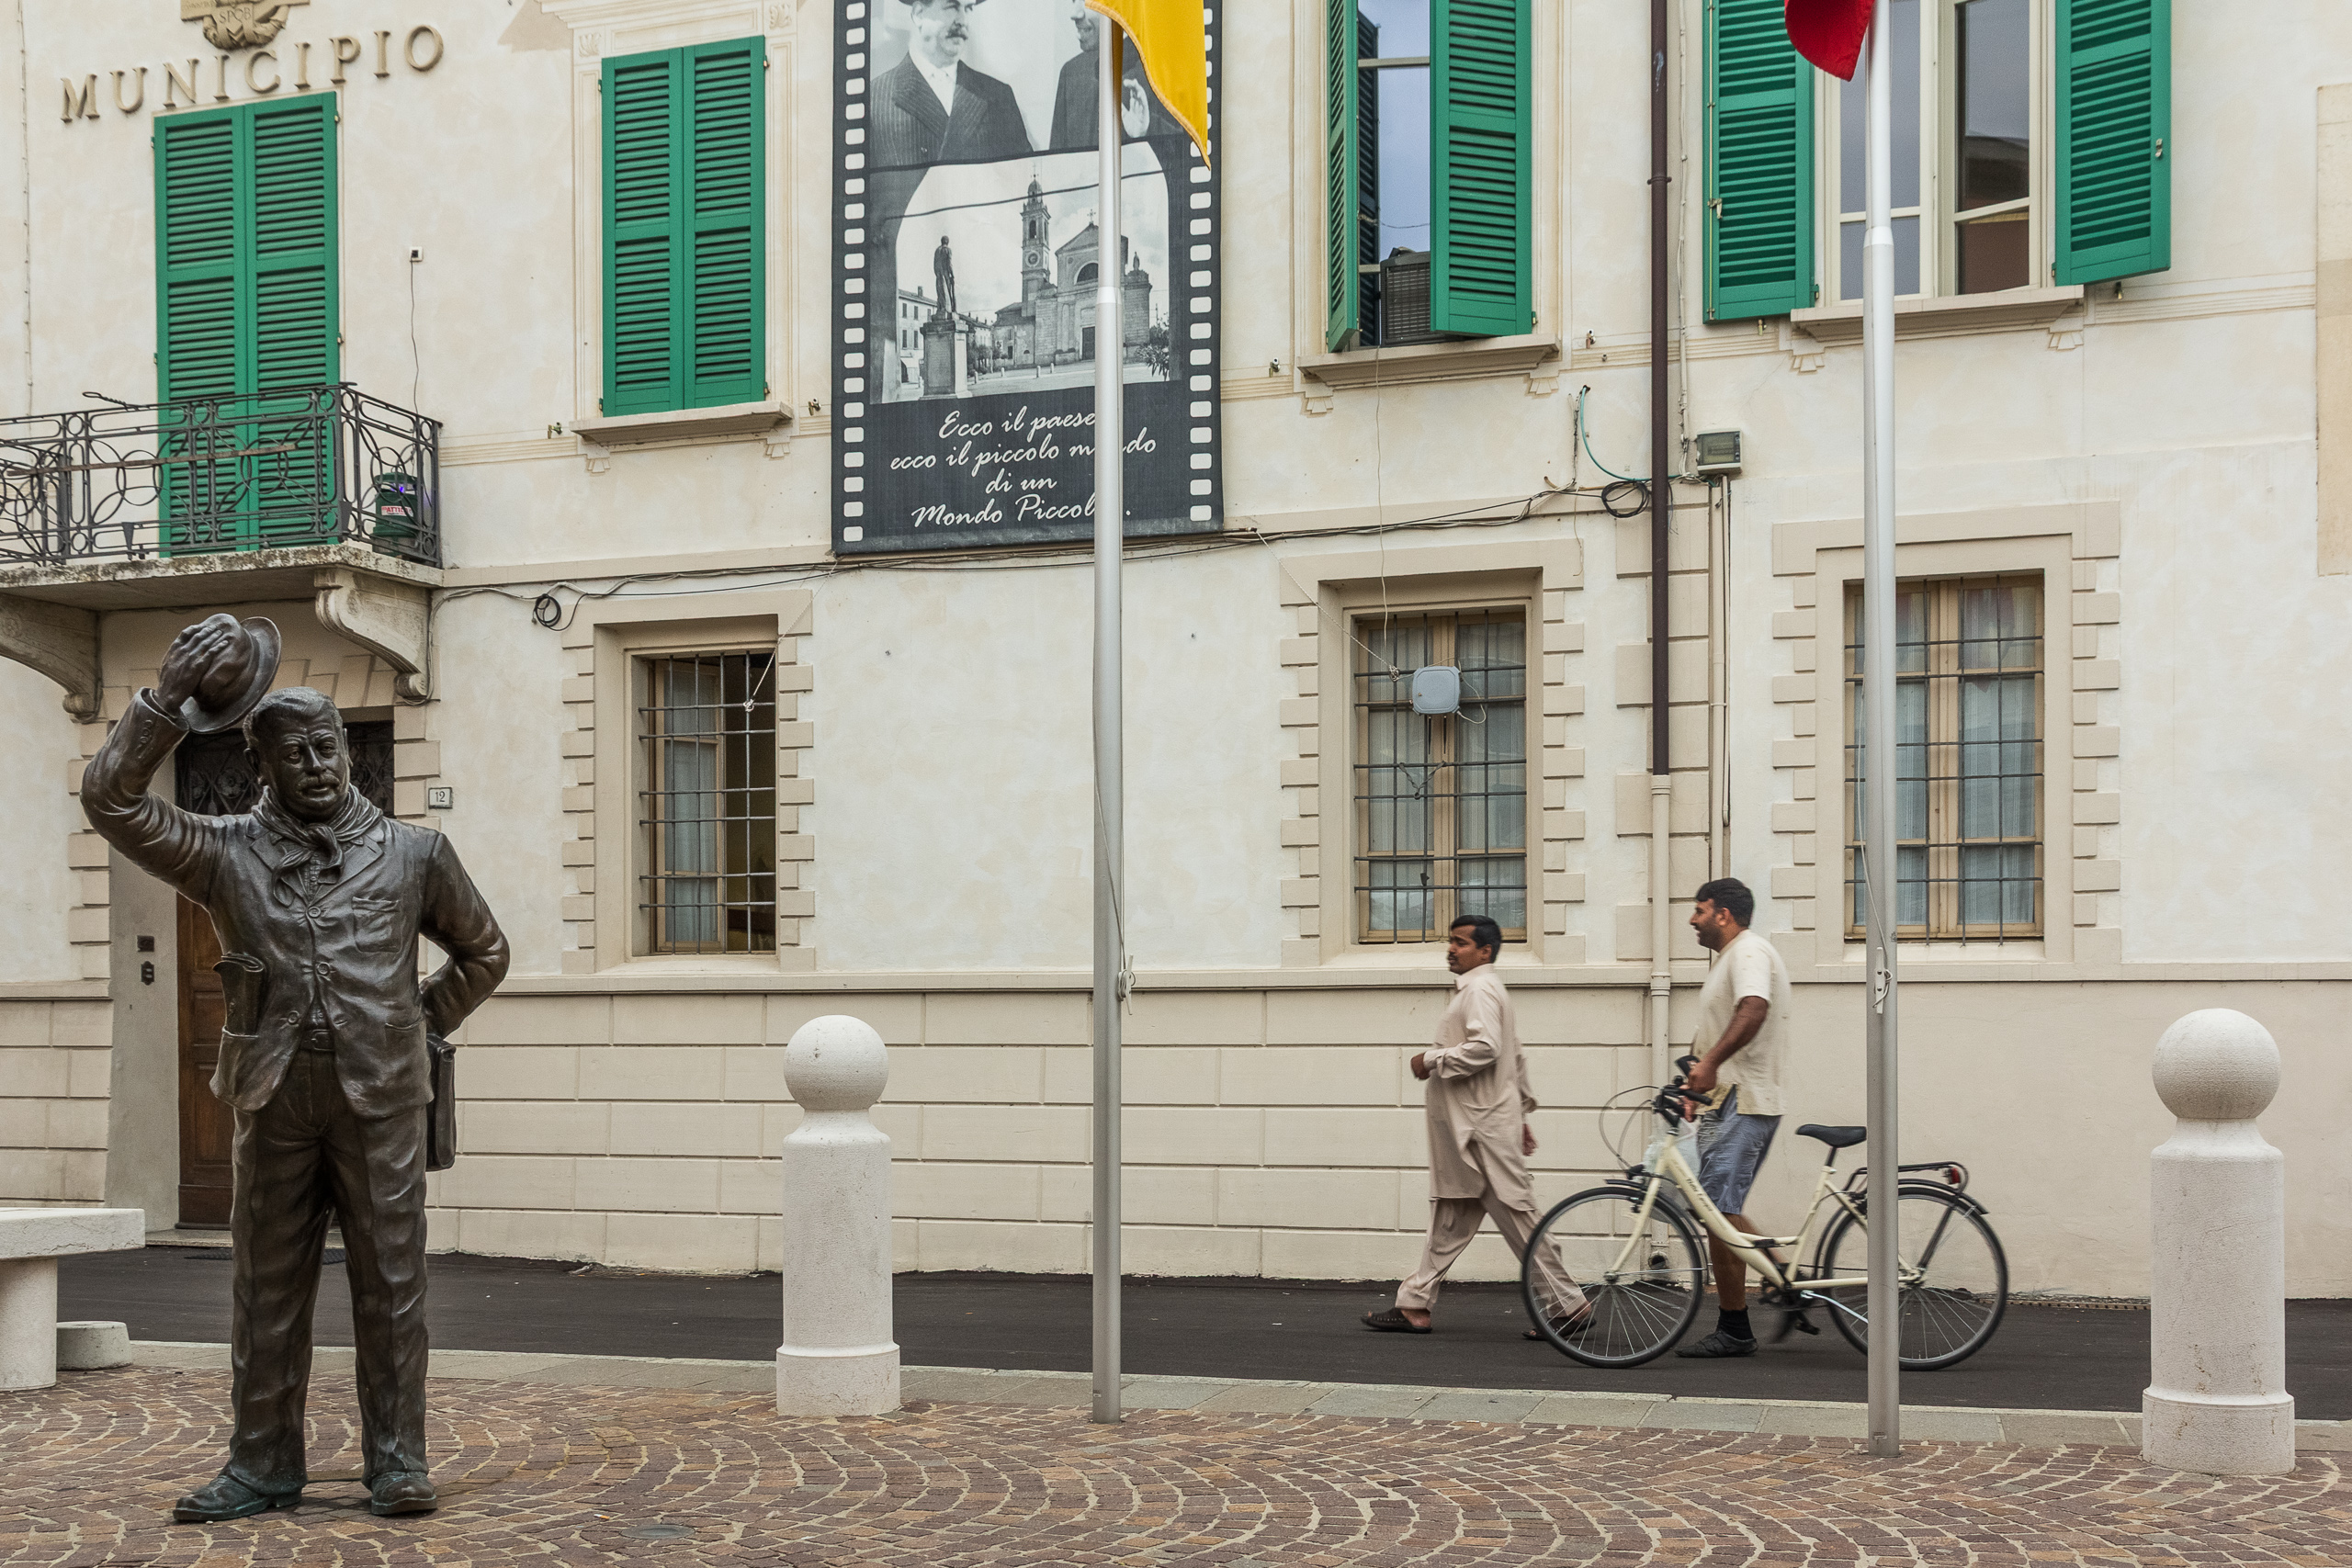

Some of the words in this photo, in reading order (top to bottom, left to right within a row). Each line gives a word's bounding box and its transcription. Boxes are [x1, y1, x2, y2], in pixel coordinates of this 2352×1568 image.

[61, 24, 445, 123] MUNICIPIO
[938, 410, 993, 438] Ecco
[1001, 405, 1028, 433] il
[1028, 412, 1095, 443] paese
[889, 454, 937, 470] ecco
[945, 440, 973, 467] il
[971, 433, 1061, 478] piccolo
[1069, 426, 1157, 457] mdo
[985, 468, 1013, 494] di
[1020, 474, 1057, 491] un
[910, 498, 1003, 528] Mondo
[1014, 493, 1132, 522] Piccol.
[435, 790, 446, 802] 12
